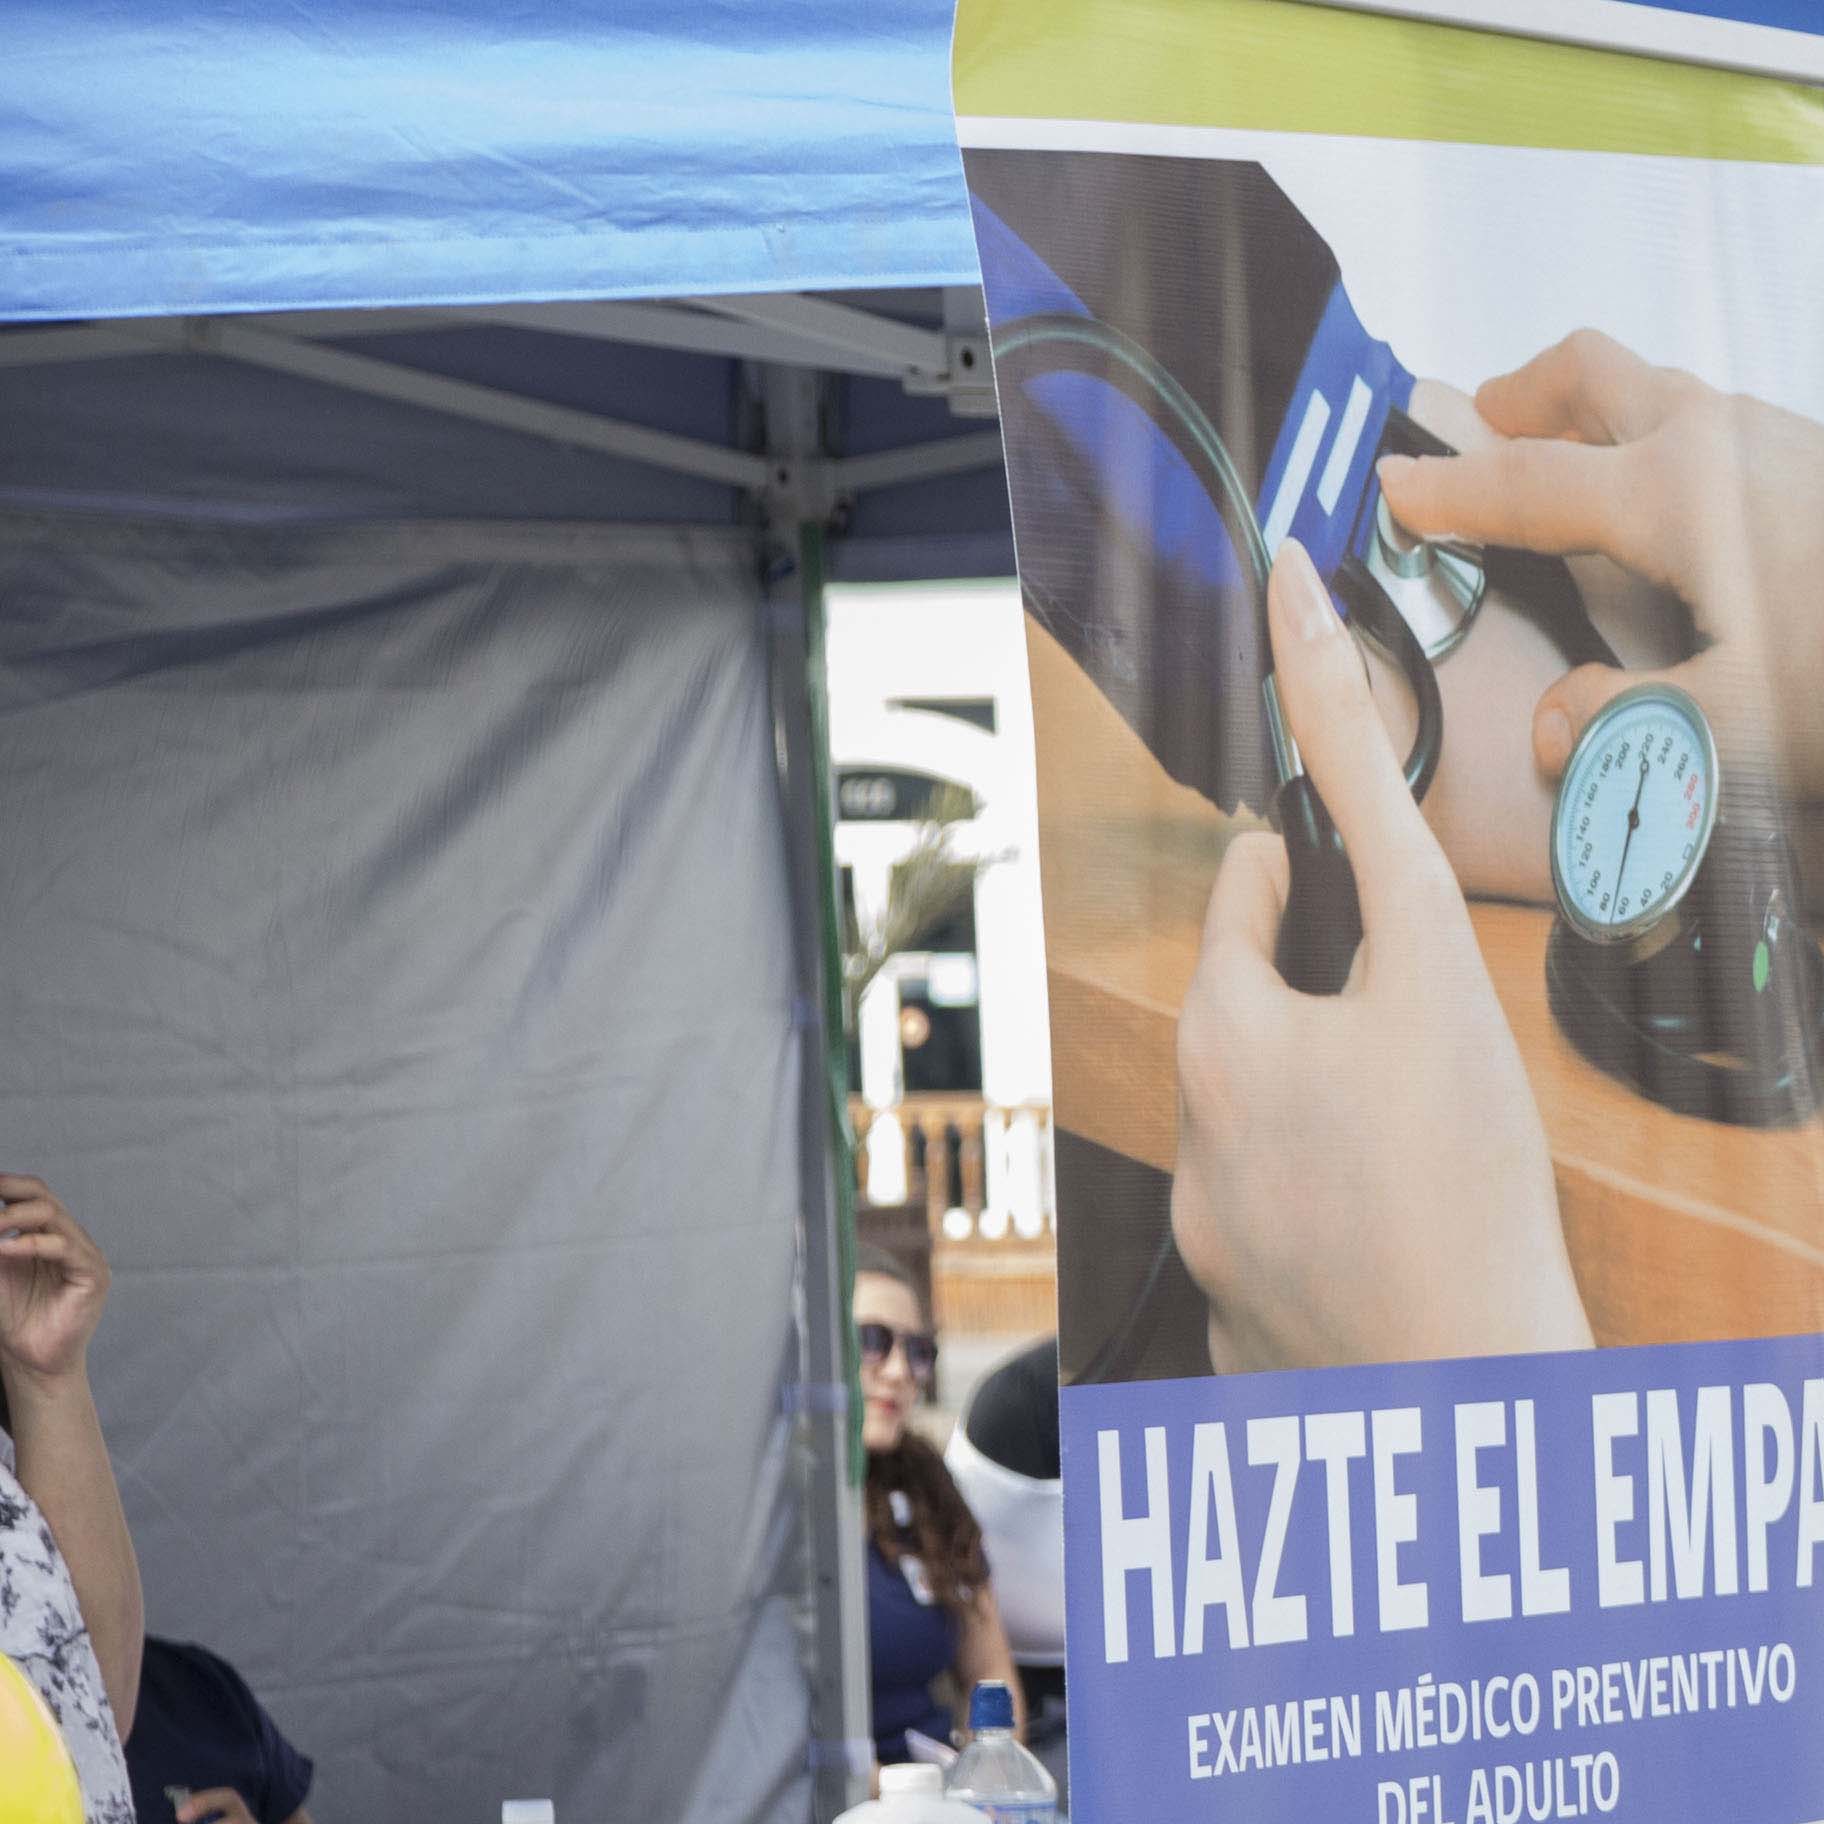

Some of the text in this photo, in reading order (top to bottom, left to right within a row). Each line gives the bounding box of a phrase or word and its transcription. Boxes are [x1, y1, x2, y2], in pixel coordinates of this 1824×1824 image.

[1576, 817, 1590, 842] 140
[1579, 842, 1593, 867] 120
[1587, 870, 1600, 896] 100
[1619, 896, 1629, 915] 60
[1640, 889, 1652, 908] 40
[1097, 1406, 1430, 1664] HAZTE
[1454, 1399, 1571, 1623] EL
[1187, 1642, 1797, 1779] EXAMEN MÉDICO PREVENTIVO
